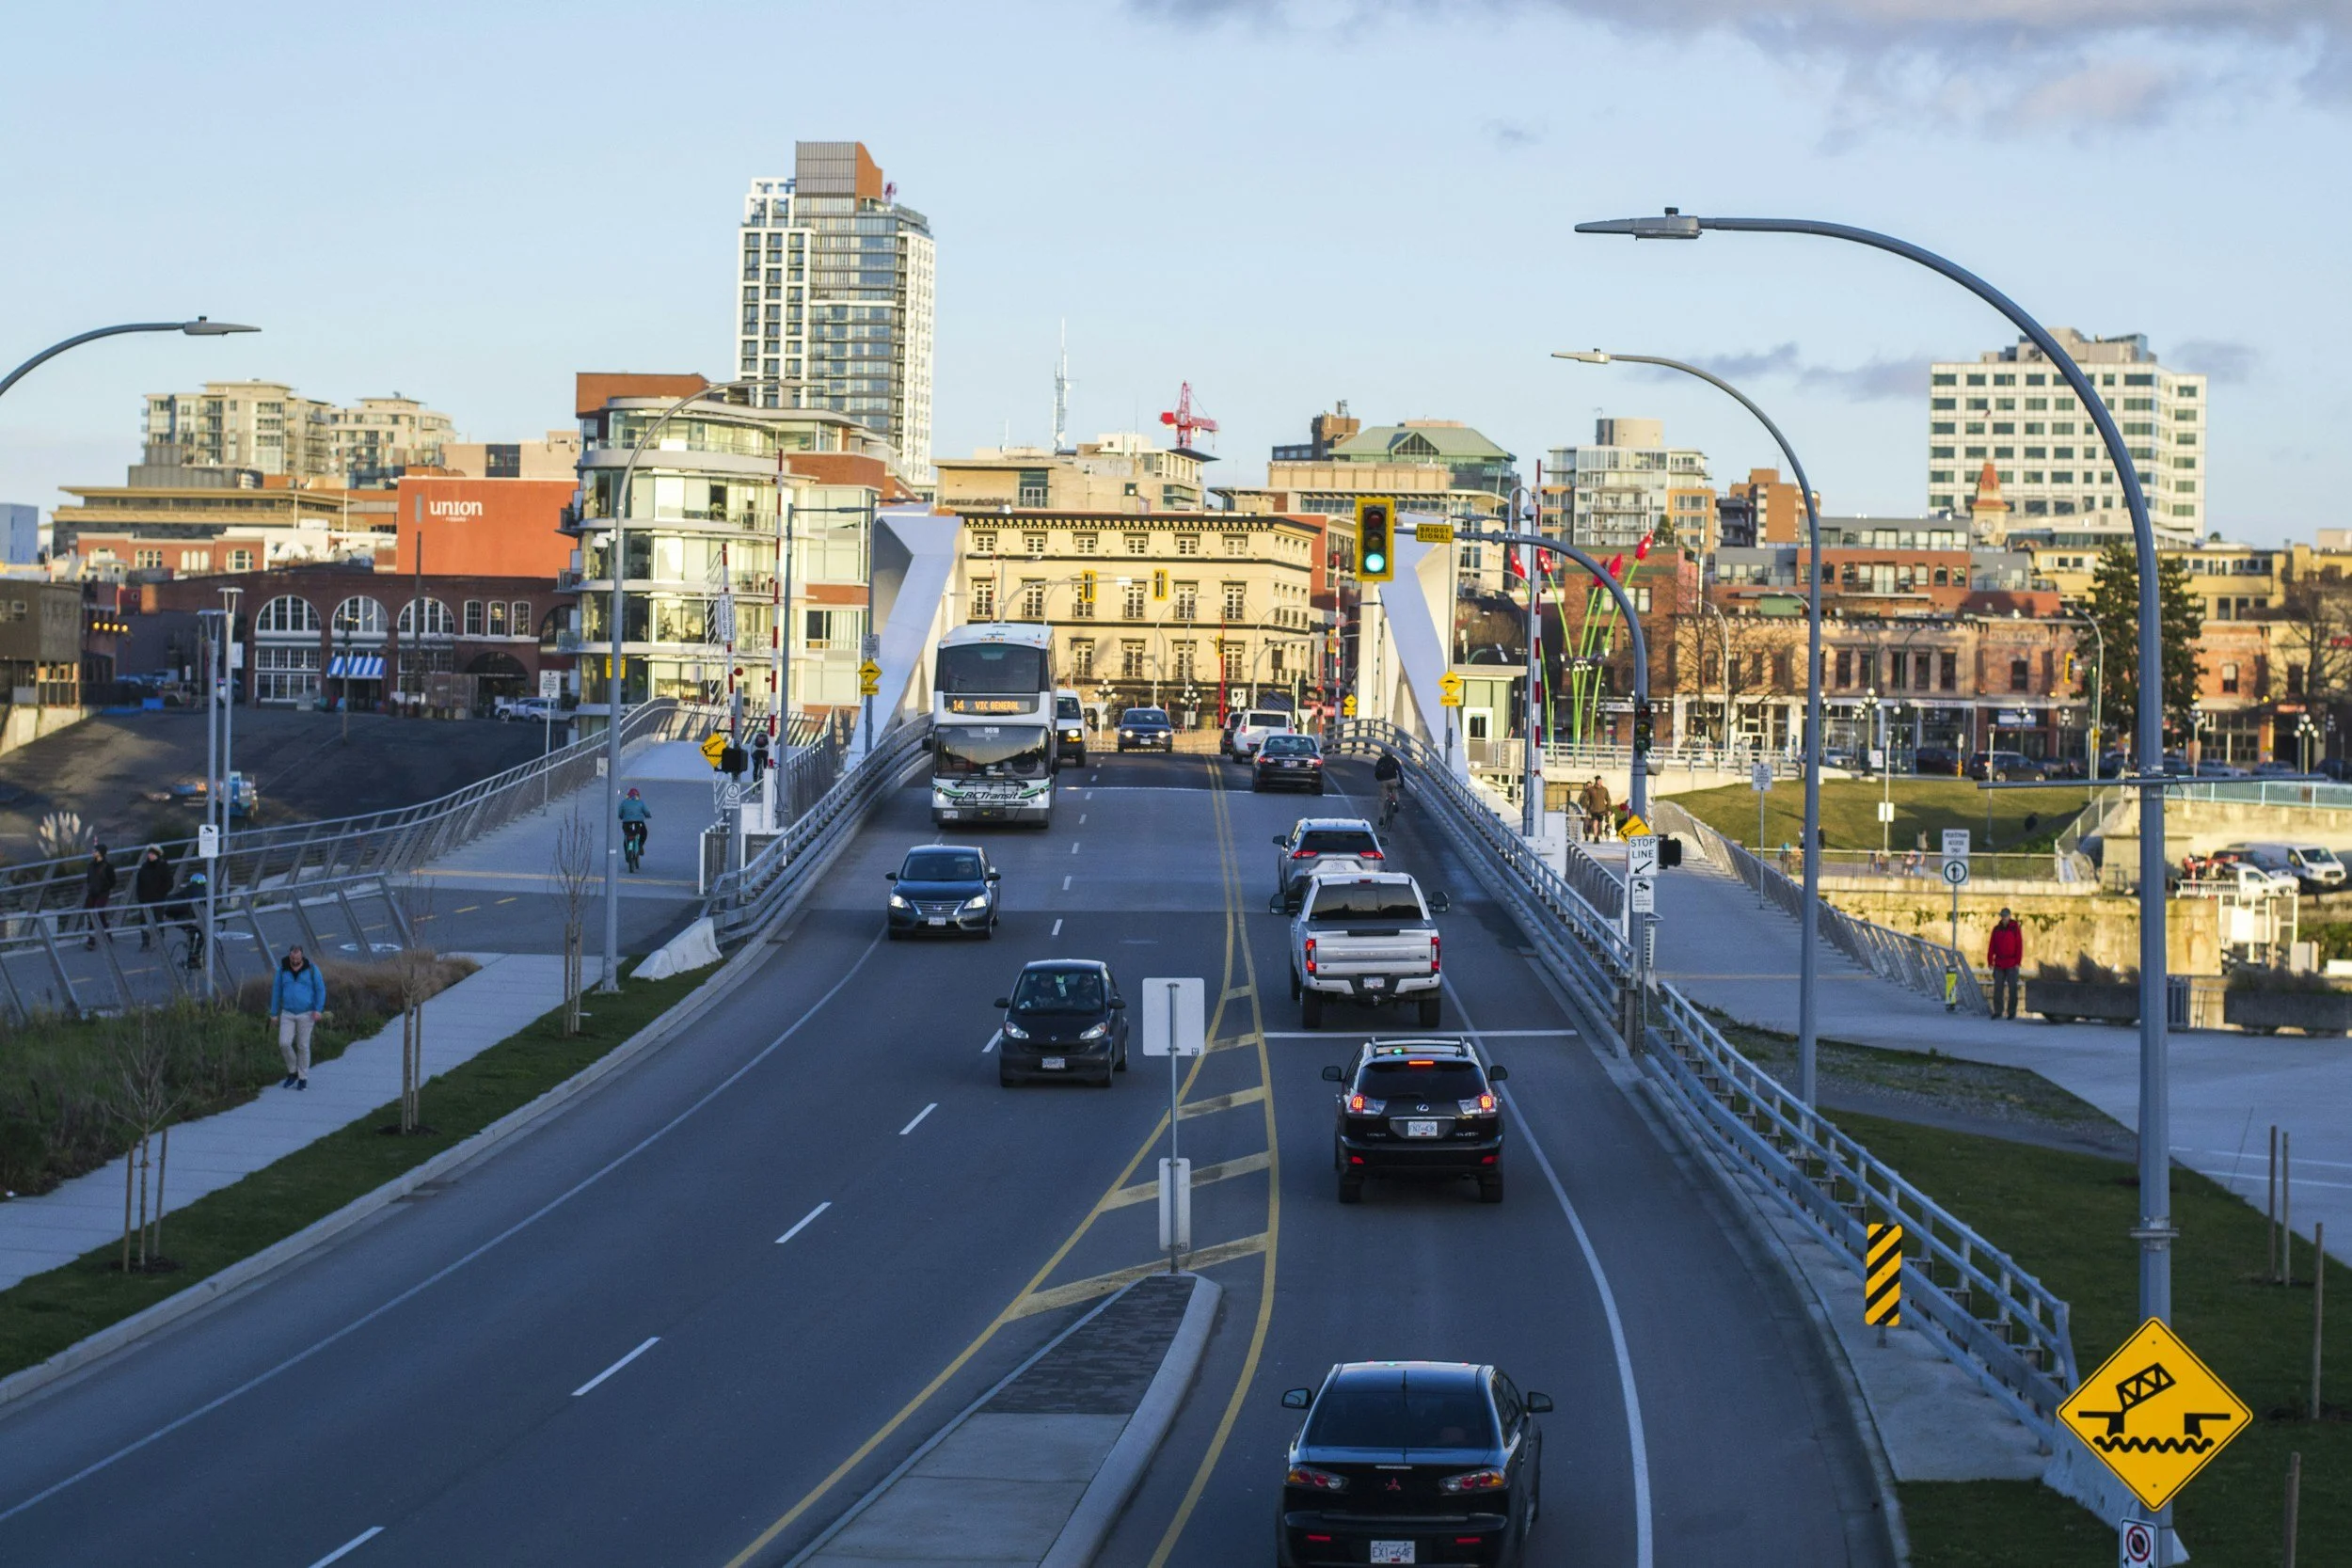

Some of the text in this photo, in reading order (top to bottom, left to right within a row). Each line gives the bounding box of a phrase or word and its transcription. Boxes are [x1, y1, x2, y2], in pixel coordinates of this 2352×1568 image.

[429, 501, 483, 515] union
[953, 700, 1020, 711] 14 VIC GENERAL
[1630, 838, 1656, 847] STOP
[1631, 849, 1654, 858] LINE
